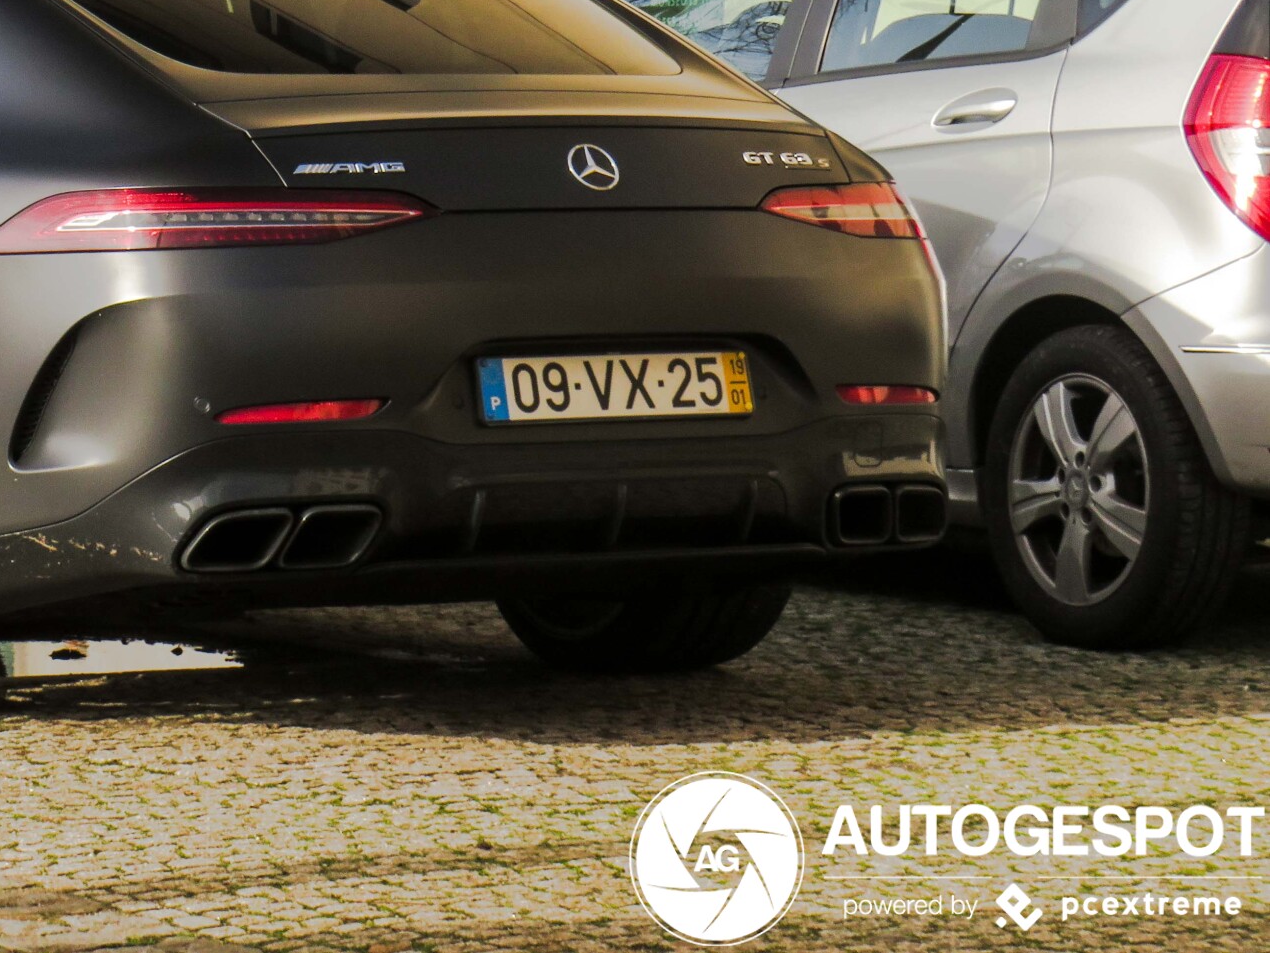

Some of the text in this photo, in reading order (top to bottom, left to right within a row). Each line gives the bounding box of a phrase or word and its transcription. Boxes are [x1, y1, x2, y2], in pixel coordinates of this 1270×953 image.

[742, 151, 774, 165] GT
[780, 152, 813, 165] 63
[329, 162, 406, 174] AMG
[730, 359, 744, 375] 19
[490, 396, 501, 410] P
[731, 389, 746, 405] 01
